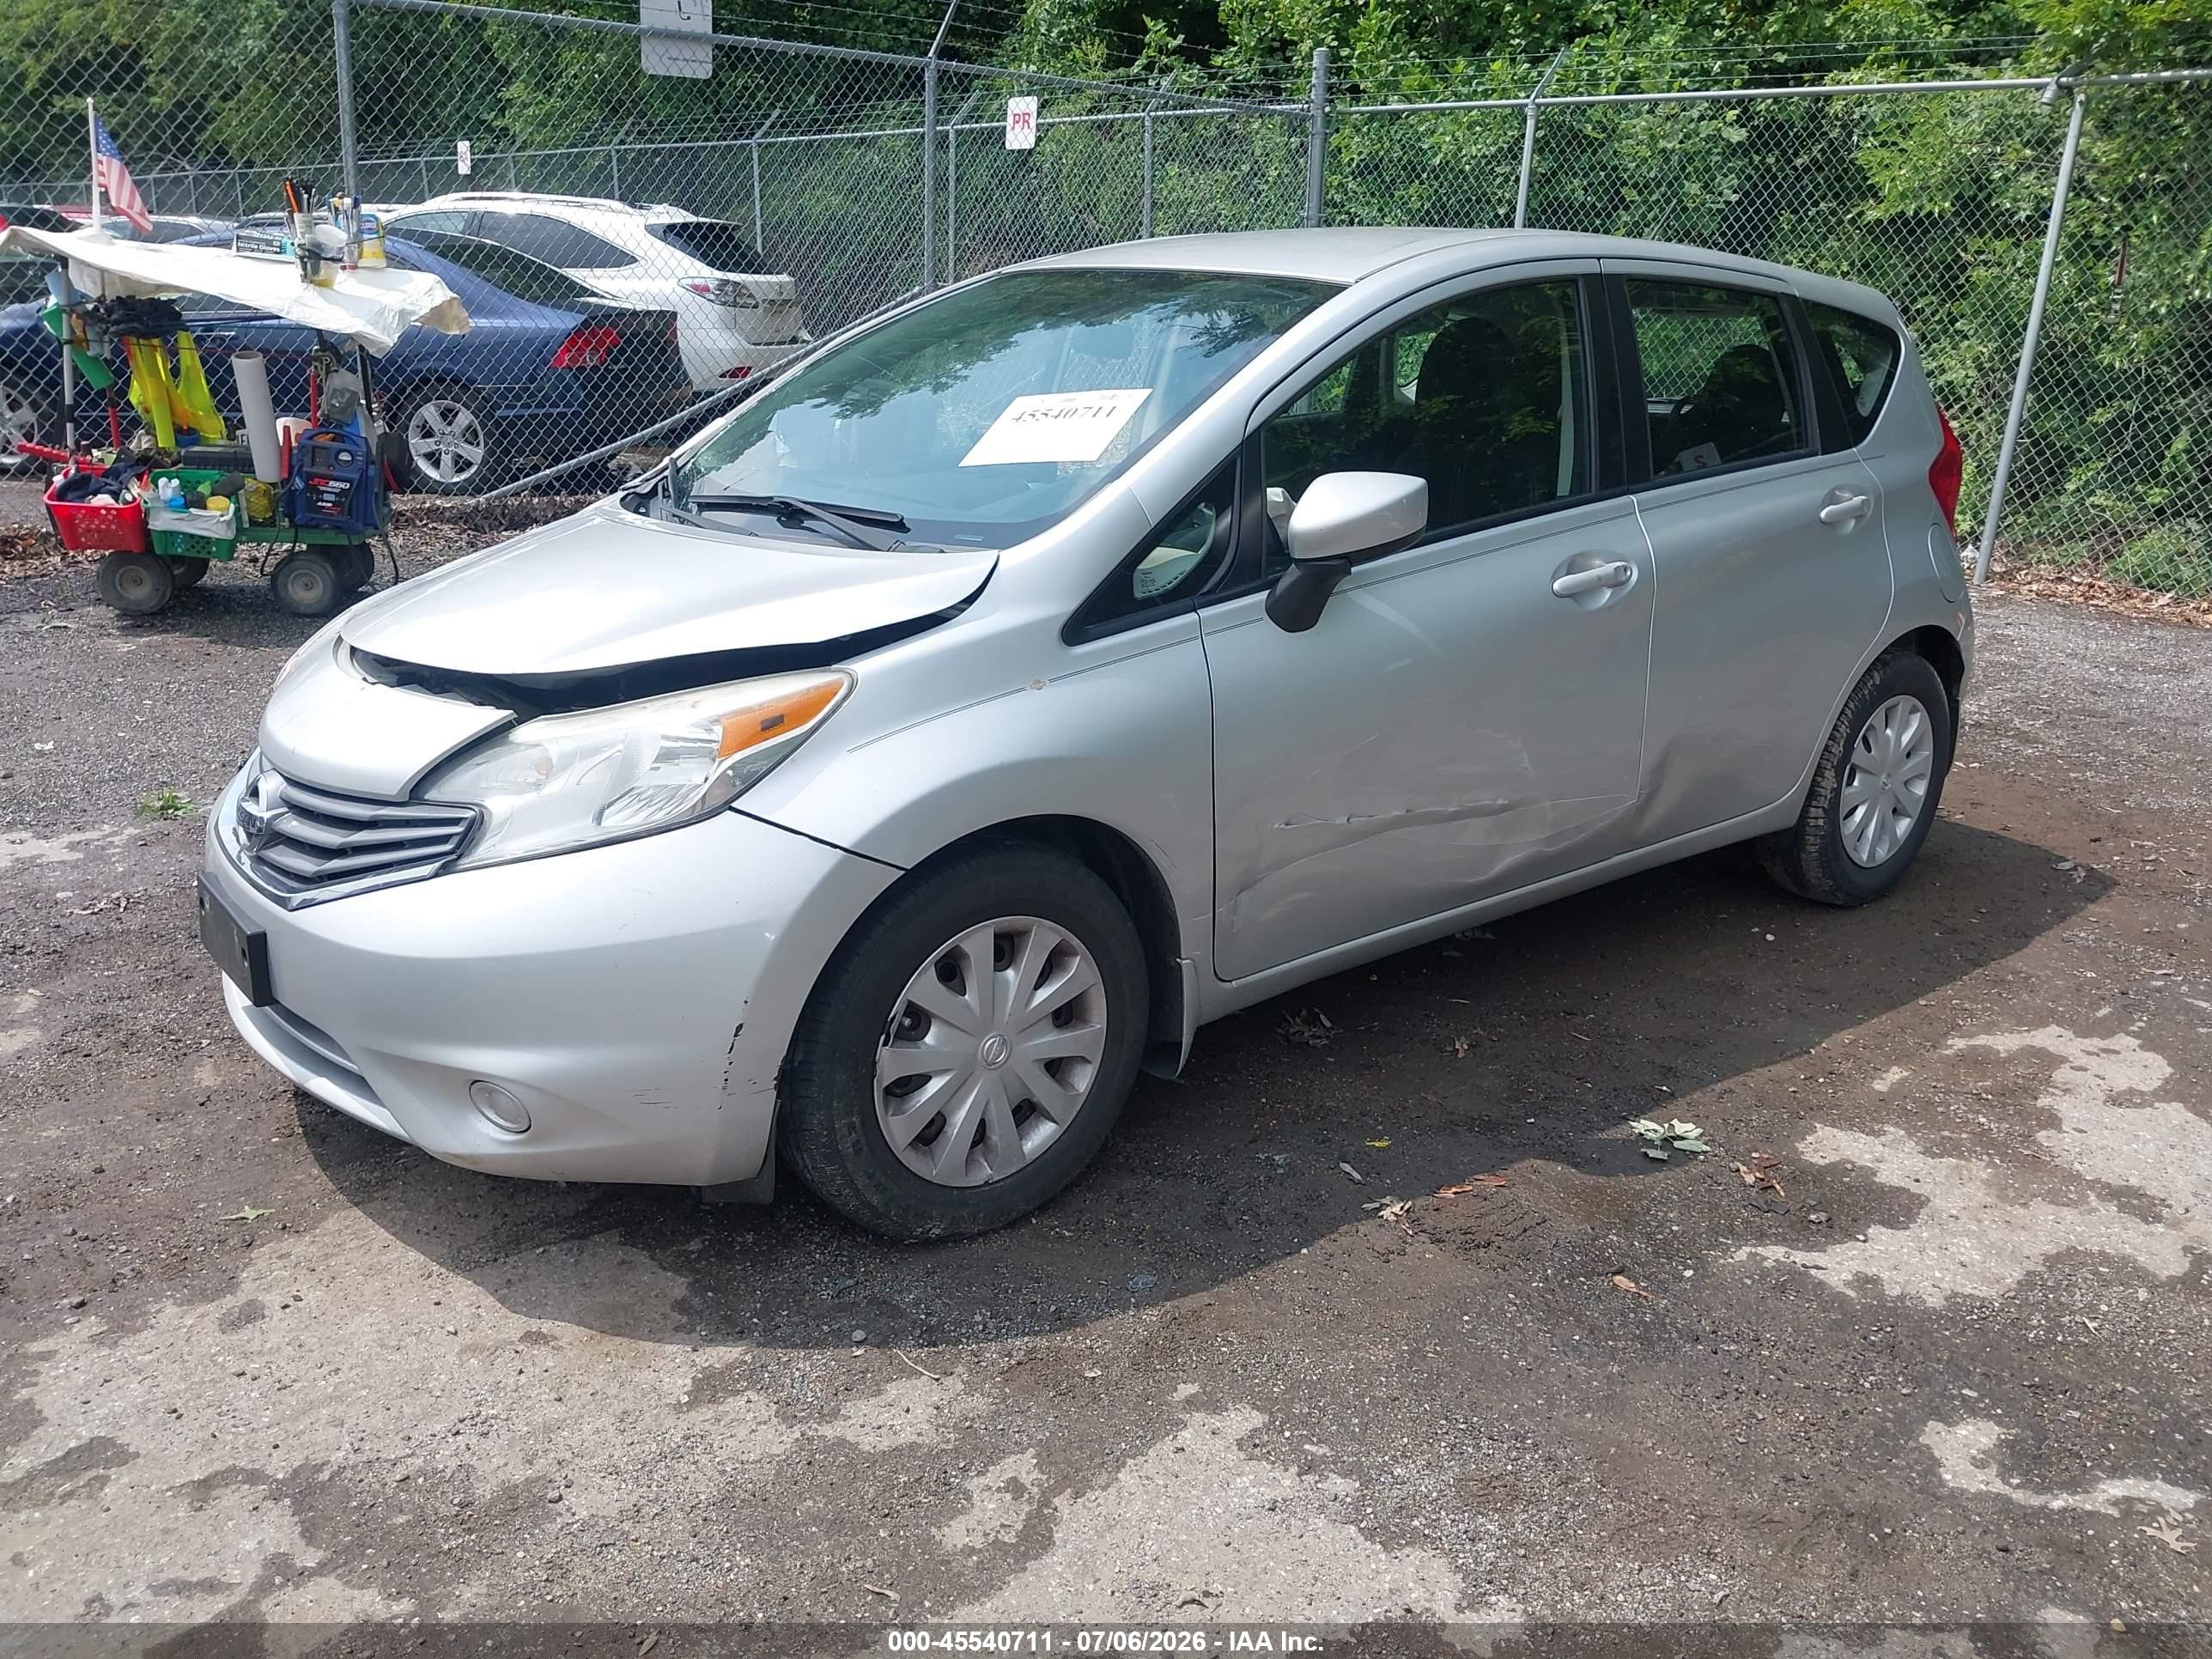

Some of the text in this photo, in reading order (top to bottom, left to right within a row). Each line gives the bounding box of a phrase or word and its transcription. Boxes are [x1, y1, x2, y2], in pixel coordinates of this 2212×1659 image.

[1012, 112, 1031, 131] PR
[258, 244, 281, 252] Gloves
[1012, 406, 1116, 422] 45540711
